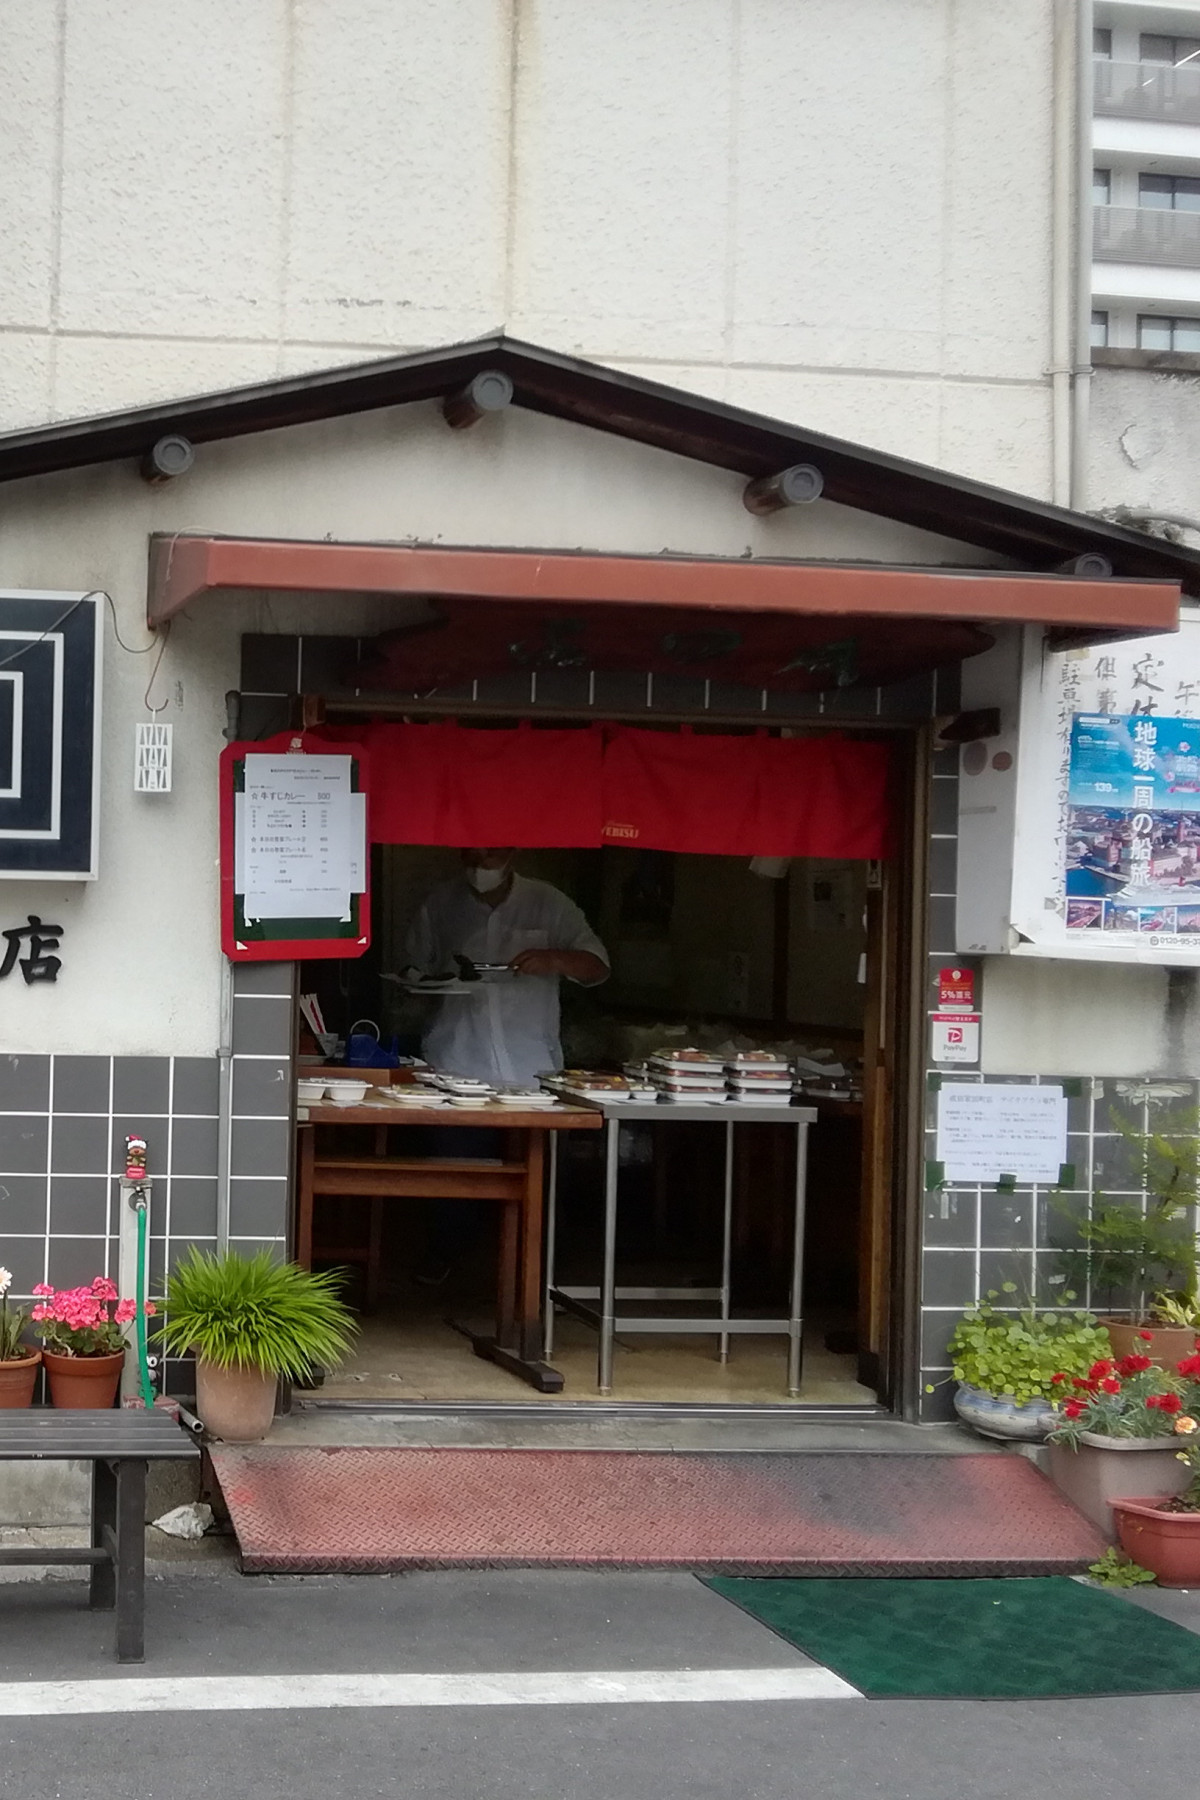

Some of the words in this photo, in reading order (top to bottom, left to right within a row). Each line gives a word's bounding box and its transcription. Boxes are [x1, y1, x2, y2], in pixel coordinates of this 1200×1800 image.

[1174, 680, 1200, 720] 午
[1131, 721, 1158, 887] 地球一周の船旅
[943, 1044, 967, 1053] PayPay
